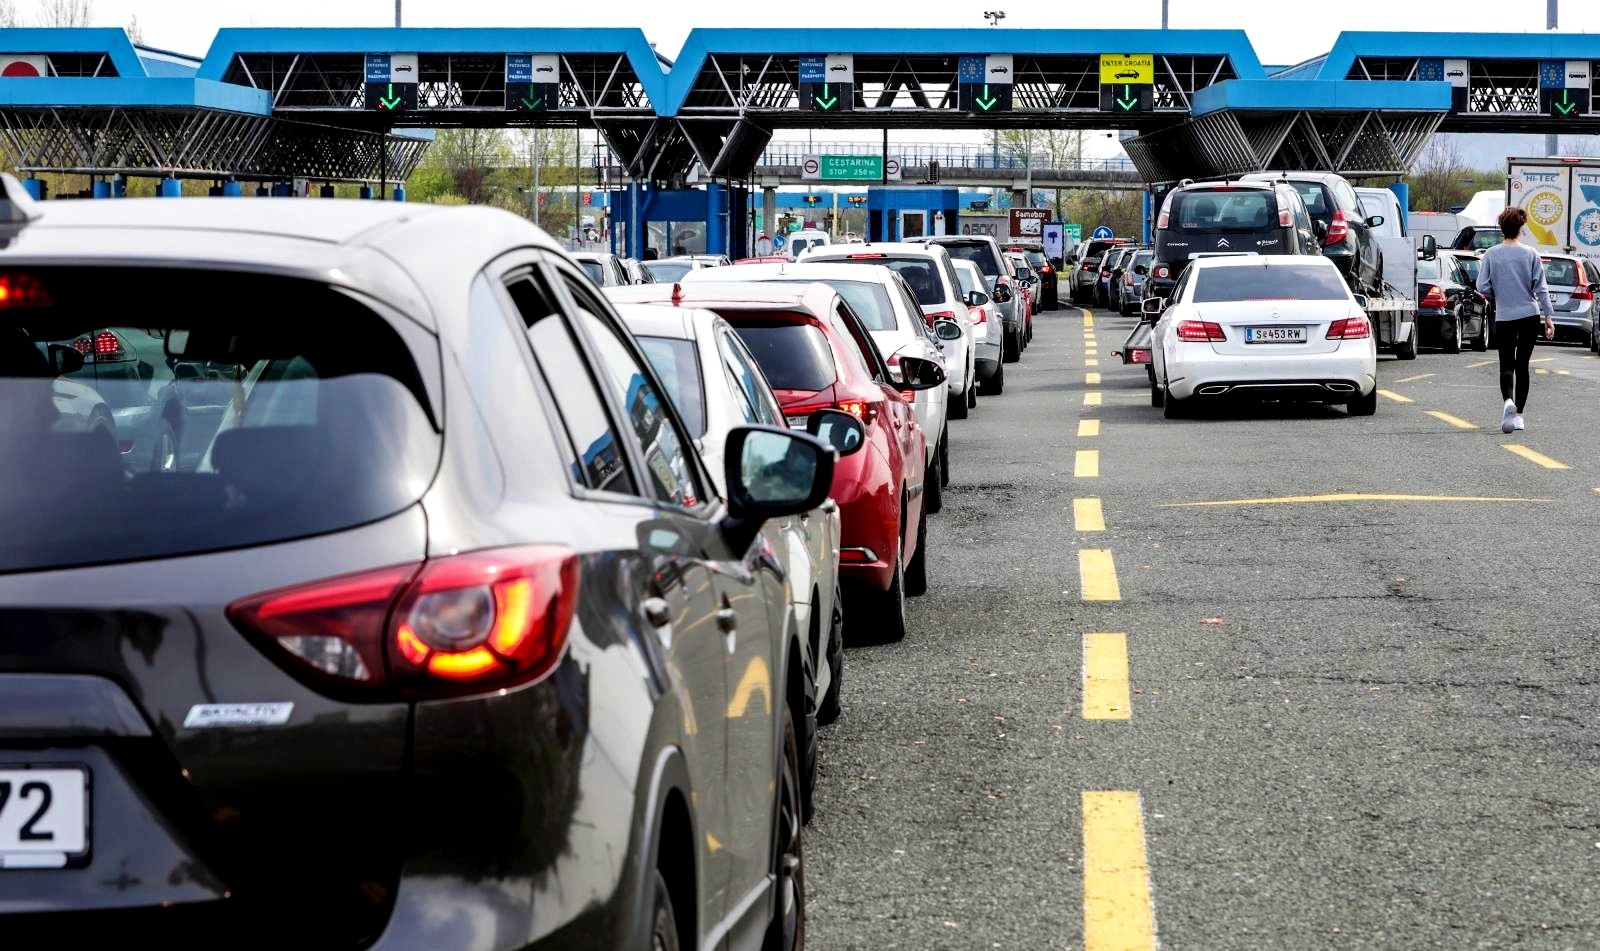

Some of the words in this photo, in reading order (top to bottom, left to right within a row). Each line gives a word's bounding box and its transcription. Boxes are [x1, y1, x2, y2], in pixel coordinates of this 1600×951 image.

[829, 158, 875, 167] CESTARINA
[854, 168, 868, 176] 250
[1015, 210, 1046, 218] Samobor
[1256, 329, 1262, 339] S
